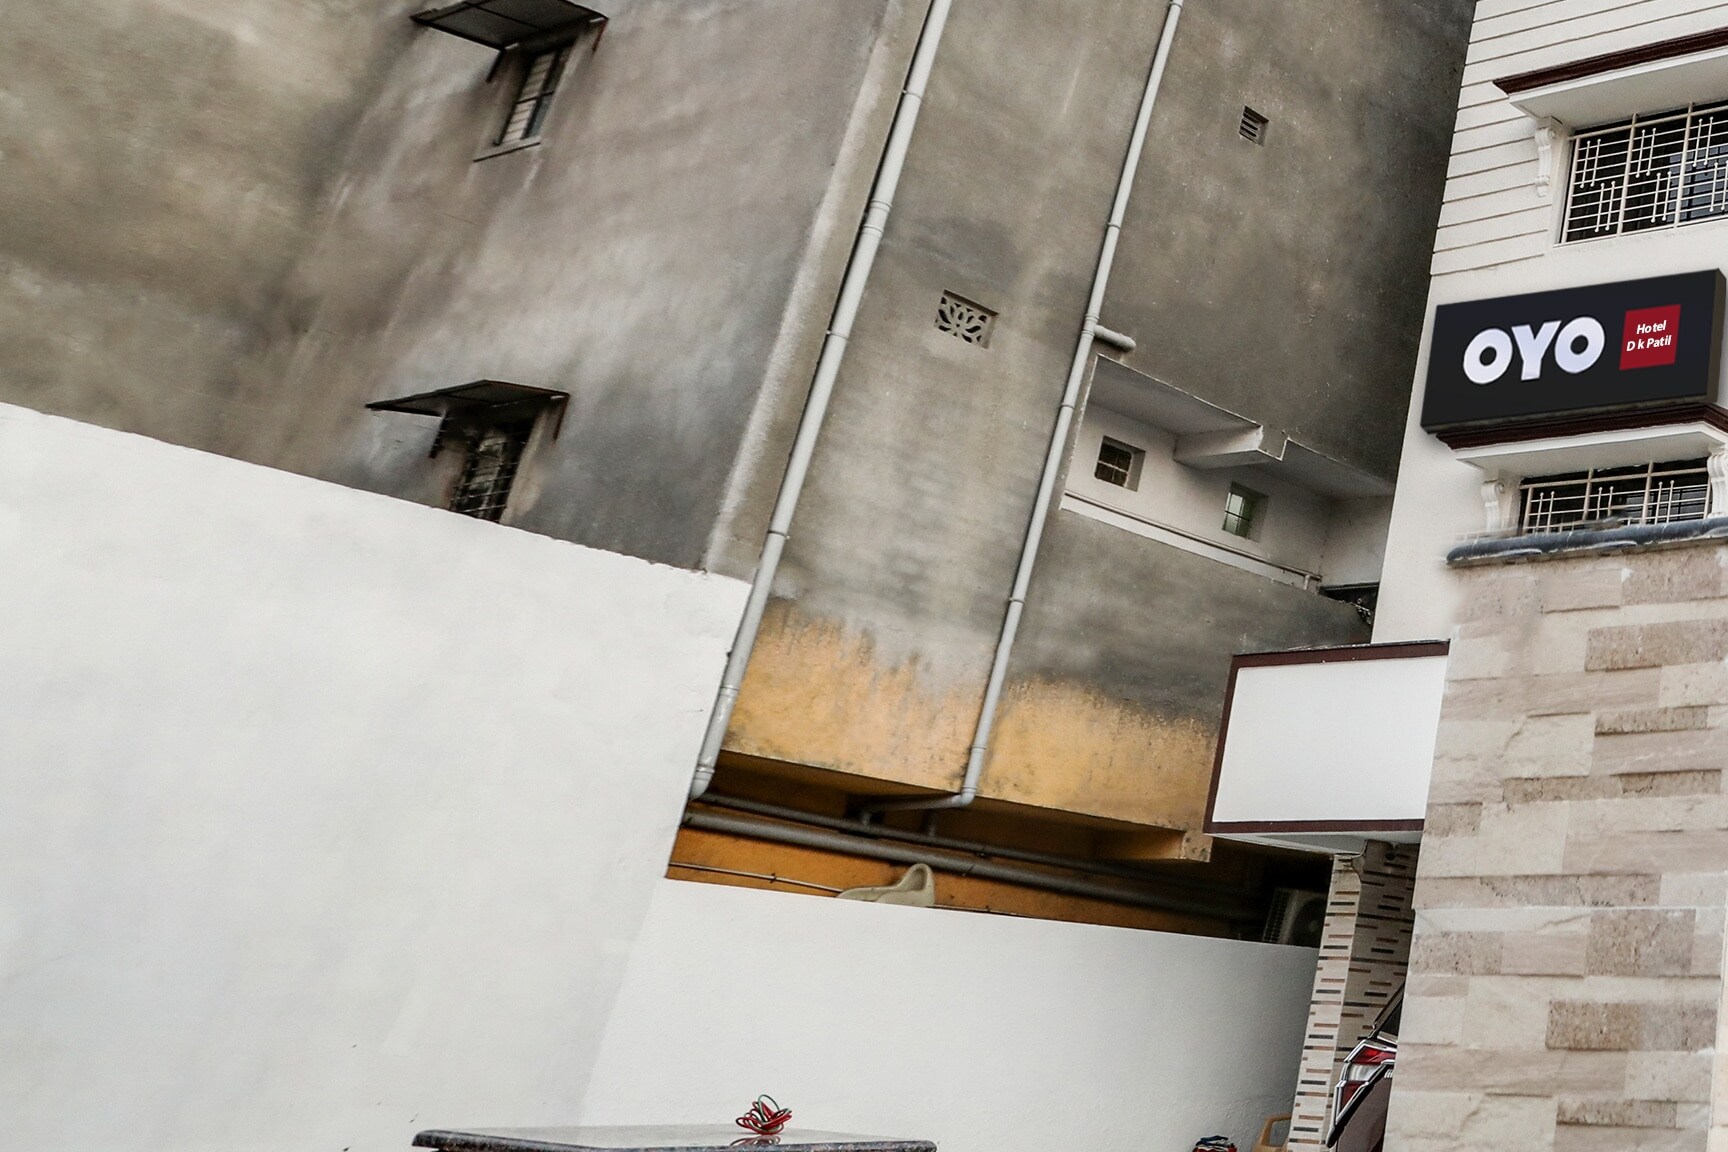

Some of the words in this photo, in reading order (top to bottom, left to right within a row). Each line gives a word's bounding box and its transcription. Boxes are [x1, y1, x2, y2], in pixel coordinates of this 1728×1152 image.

[1636, 319, 1667, 335] Hotel
[1463, 316, 1605, 385] OYO
[1626, 340, 1636, 352] D
[1646, 334, 1672, 349] Patil
